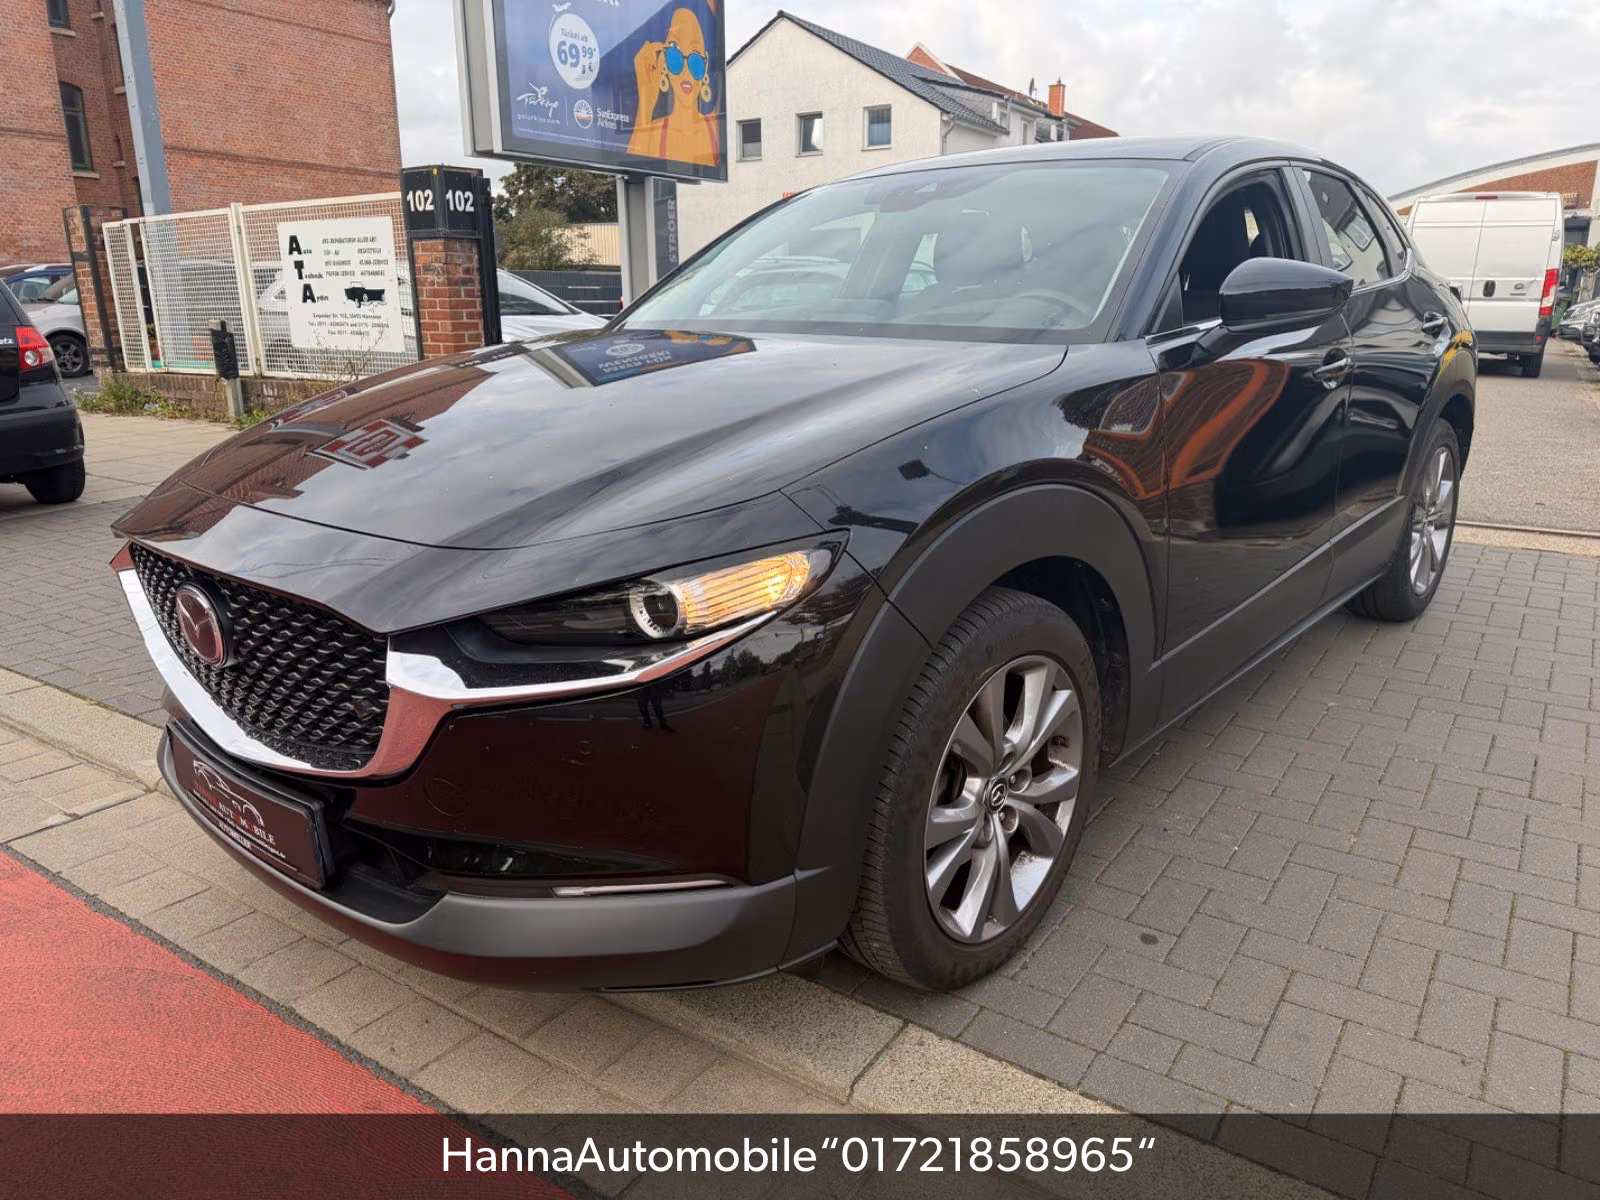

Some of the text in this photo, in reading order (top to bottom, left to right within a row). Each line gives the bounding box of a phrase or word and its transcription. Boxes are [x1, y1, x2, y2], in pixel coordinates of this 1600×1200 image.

[581, 34, 589, 42] ab
[557, 40, 580, 68] 69
[596, 107, 630, 123] SunExpress
[406, 189, 434, 212] 102
[446, 189, 475, 212] 102
